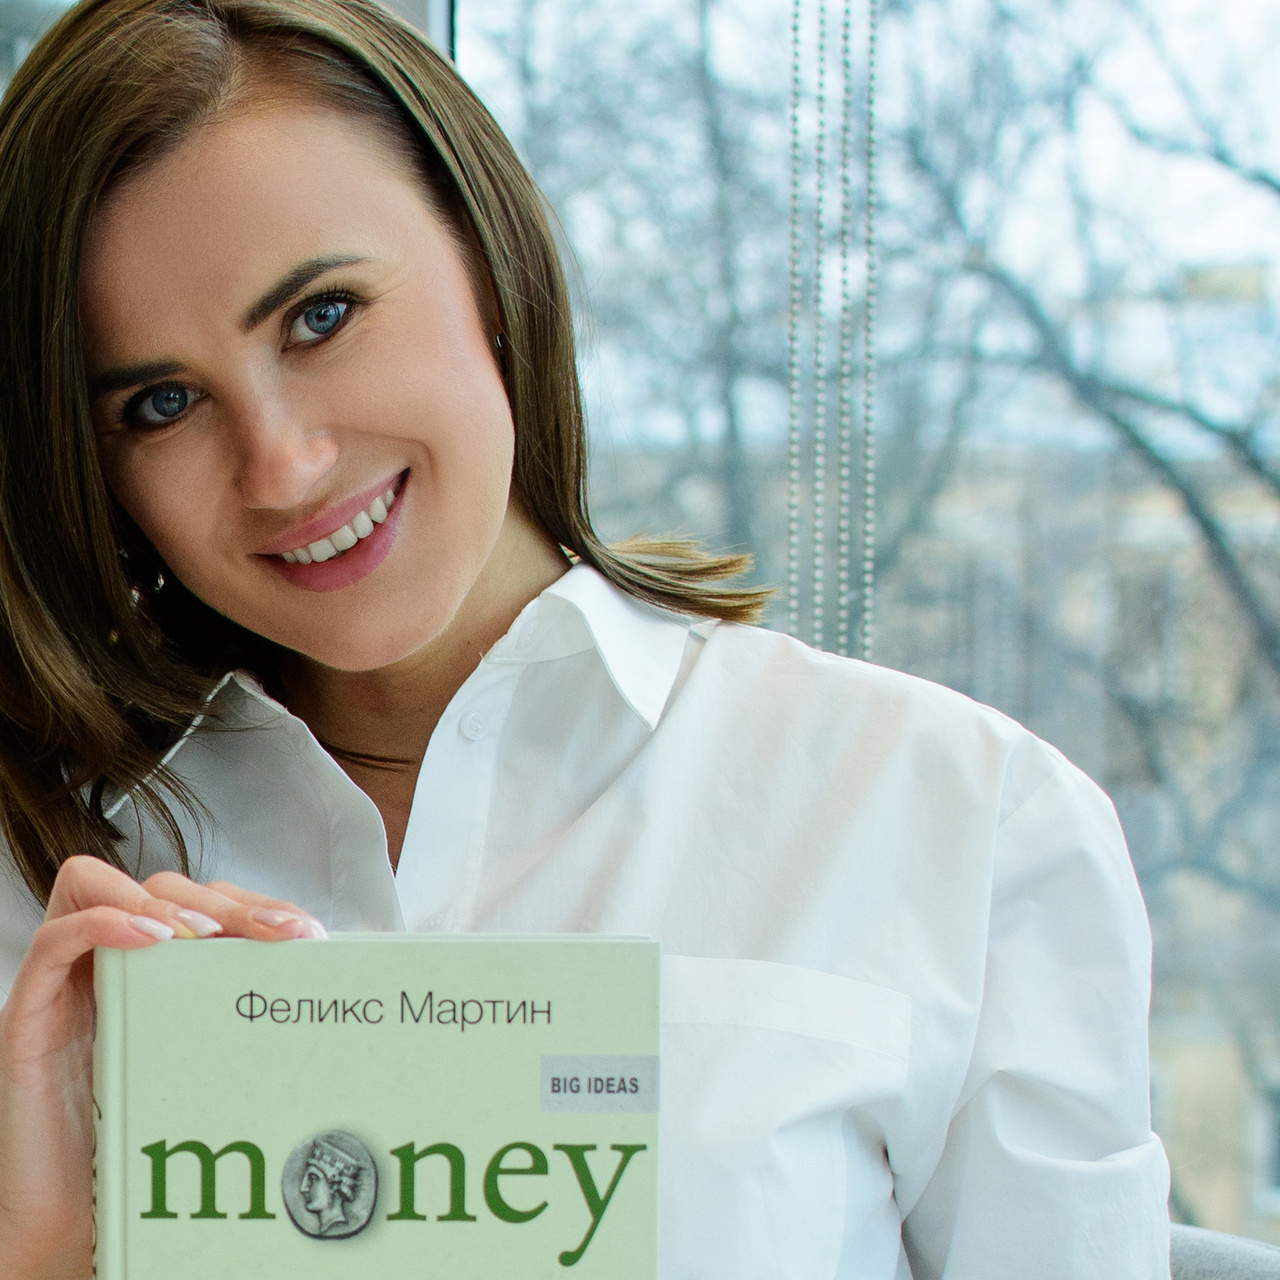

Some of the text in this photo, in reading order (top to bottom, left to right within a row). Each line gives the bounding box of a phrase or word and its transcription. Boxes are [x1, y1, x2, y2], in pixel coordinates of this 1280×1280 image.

[234, 989, 552, 1033] Феликс Мартин
[550, 1076, 640, 1095] BIG IDEAS
